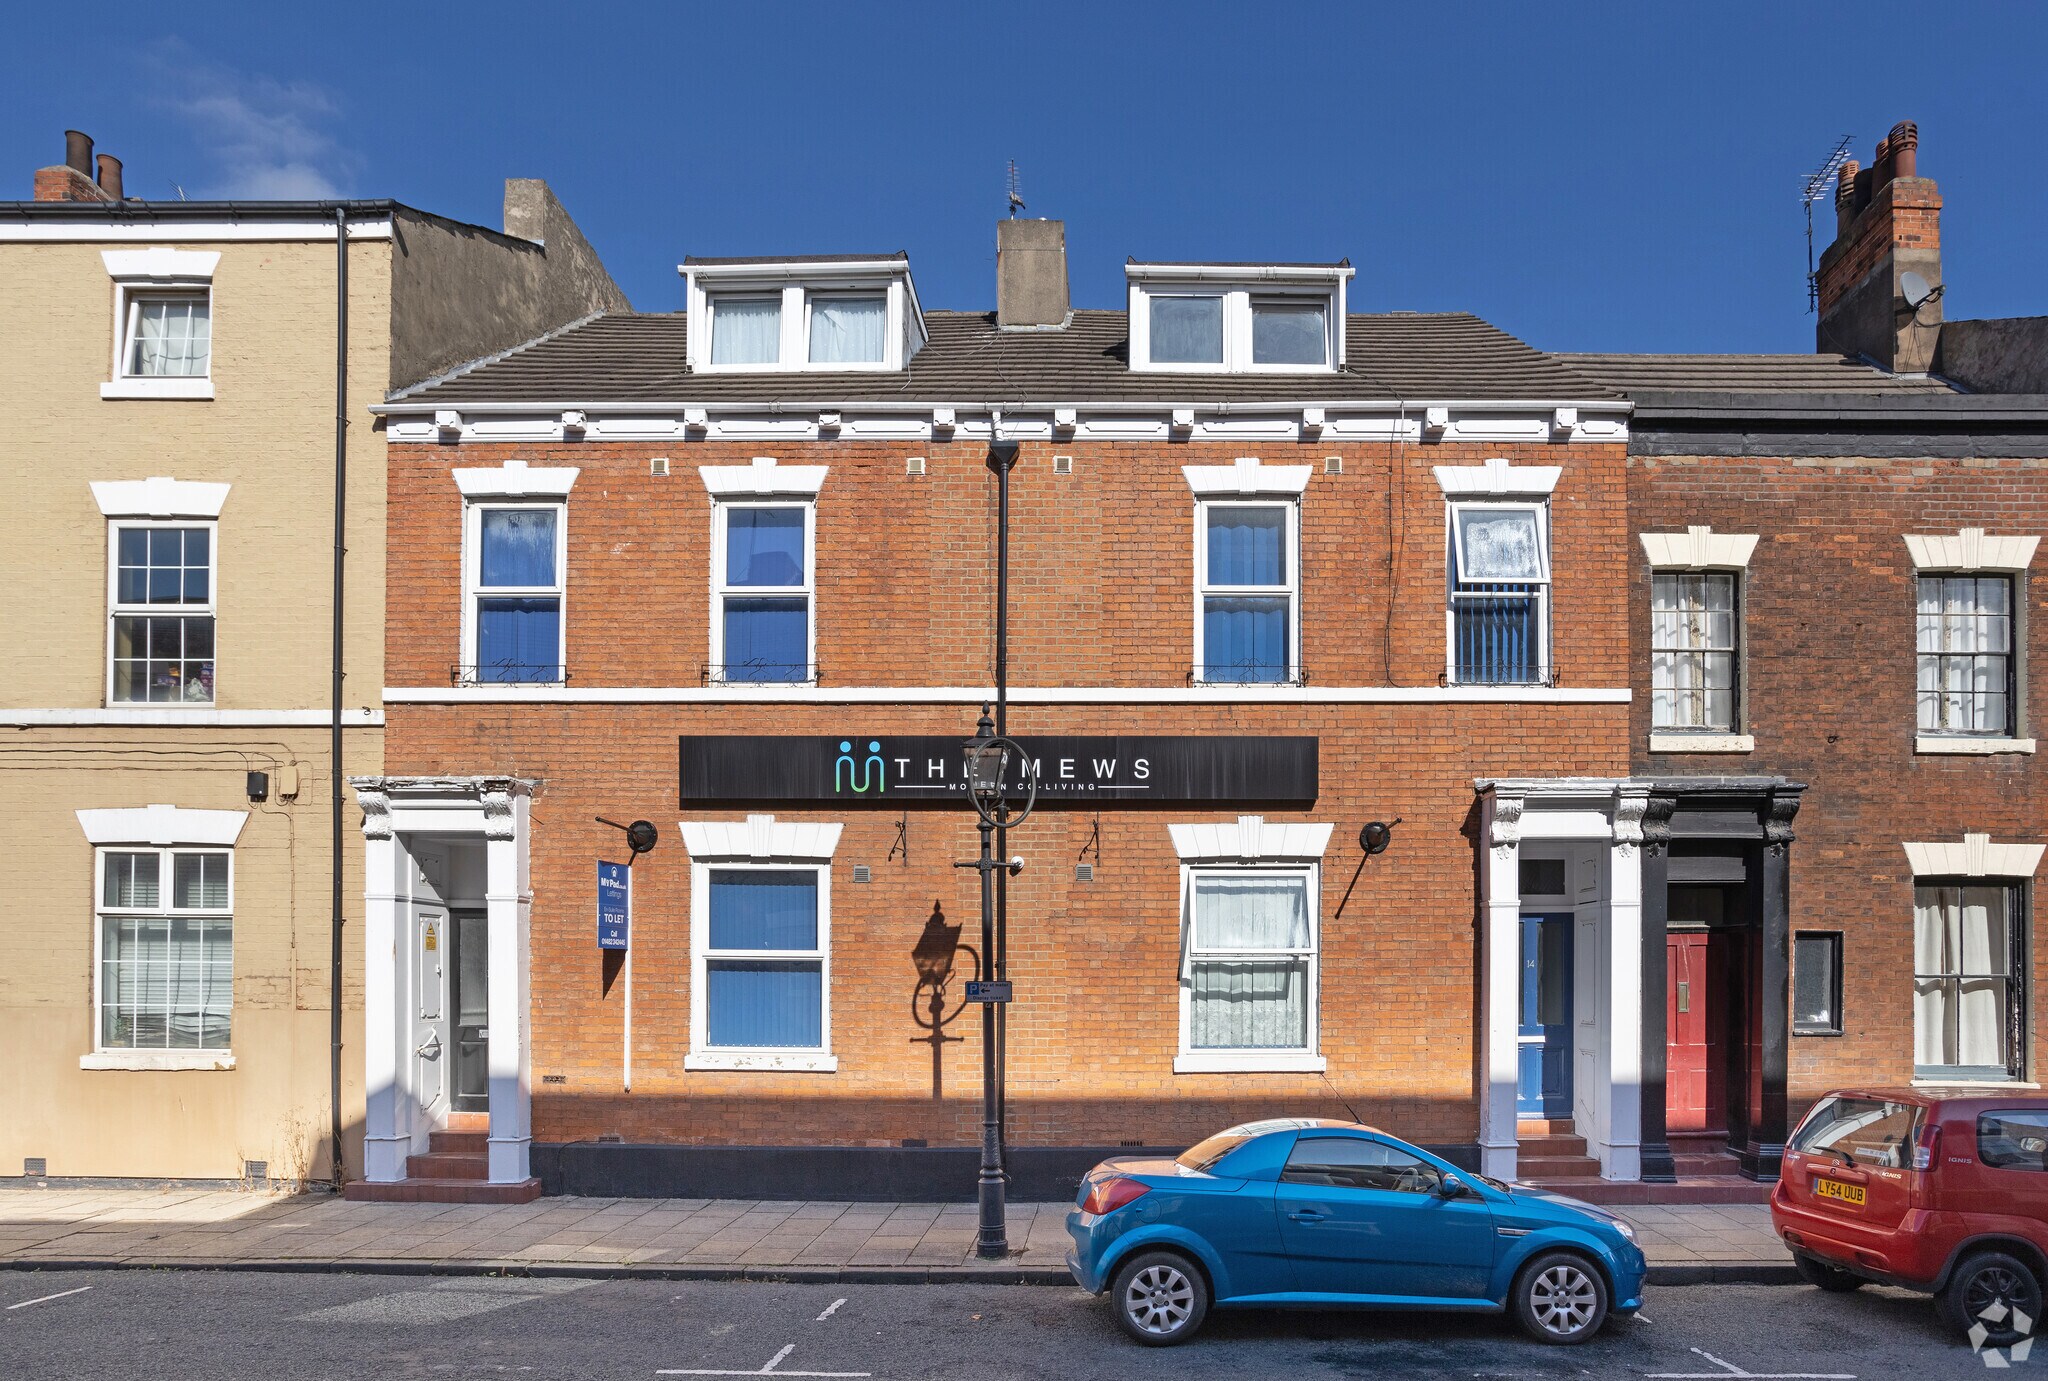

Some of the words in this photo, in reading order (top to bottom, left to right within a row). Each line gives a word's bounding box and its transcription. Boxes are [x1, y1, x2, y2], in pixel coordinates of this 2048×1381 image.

[894, 758, 979, 778] THE
[1021, 758, 1150, 779] MEWS
[604, 913, 614, 923] TO
[614, 914, 625, 924] LET
[1526, 959, 1535, 968] 14
[969, 984, 978, 994] P
[1948, 1156, 1973, 1164] IGNIS
[1881, 1171, 1902, 1180] IGNIS
[1818, 1180, 1842, 1197] LY54
